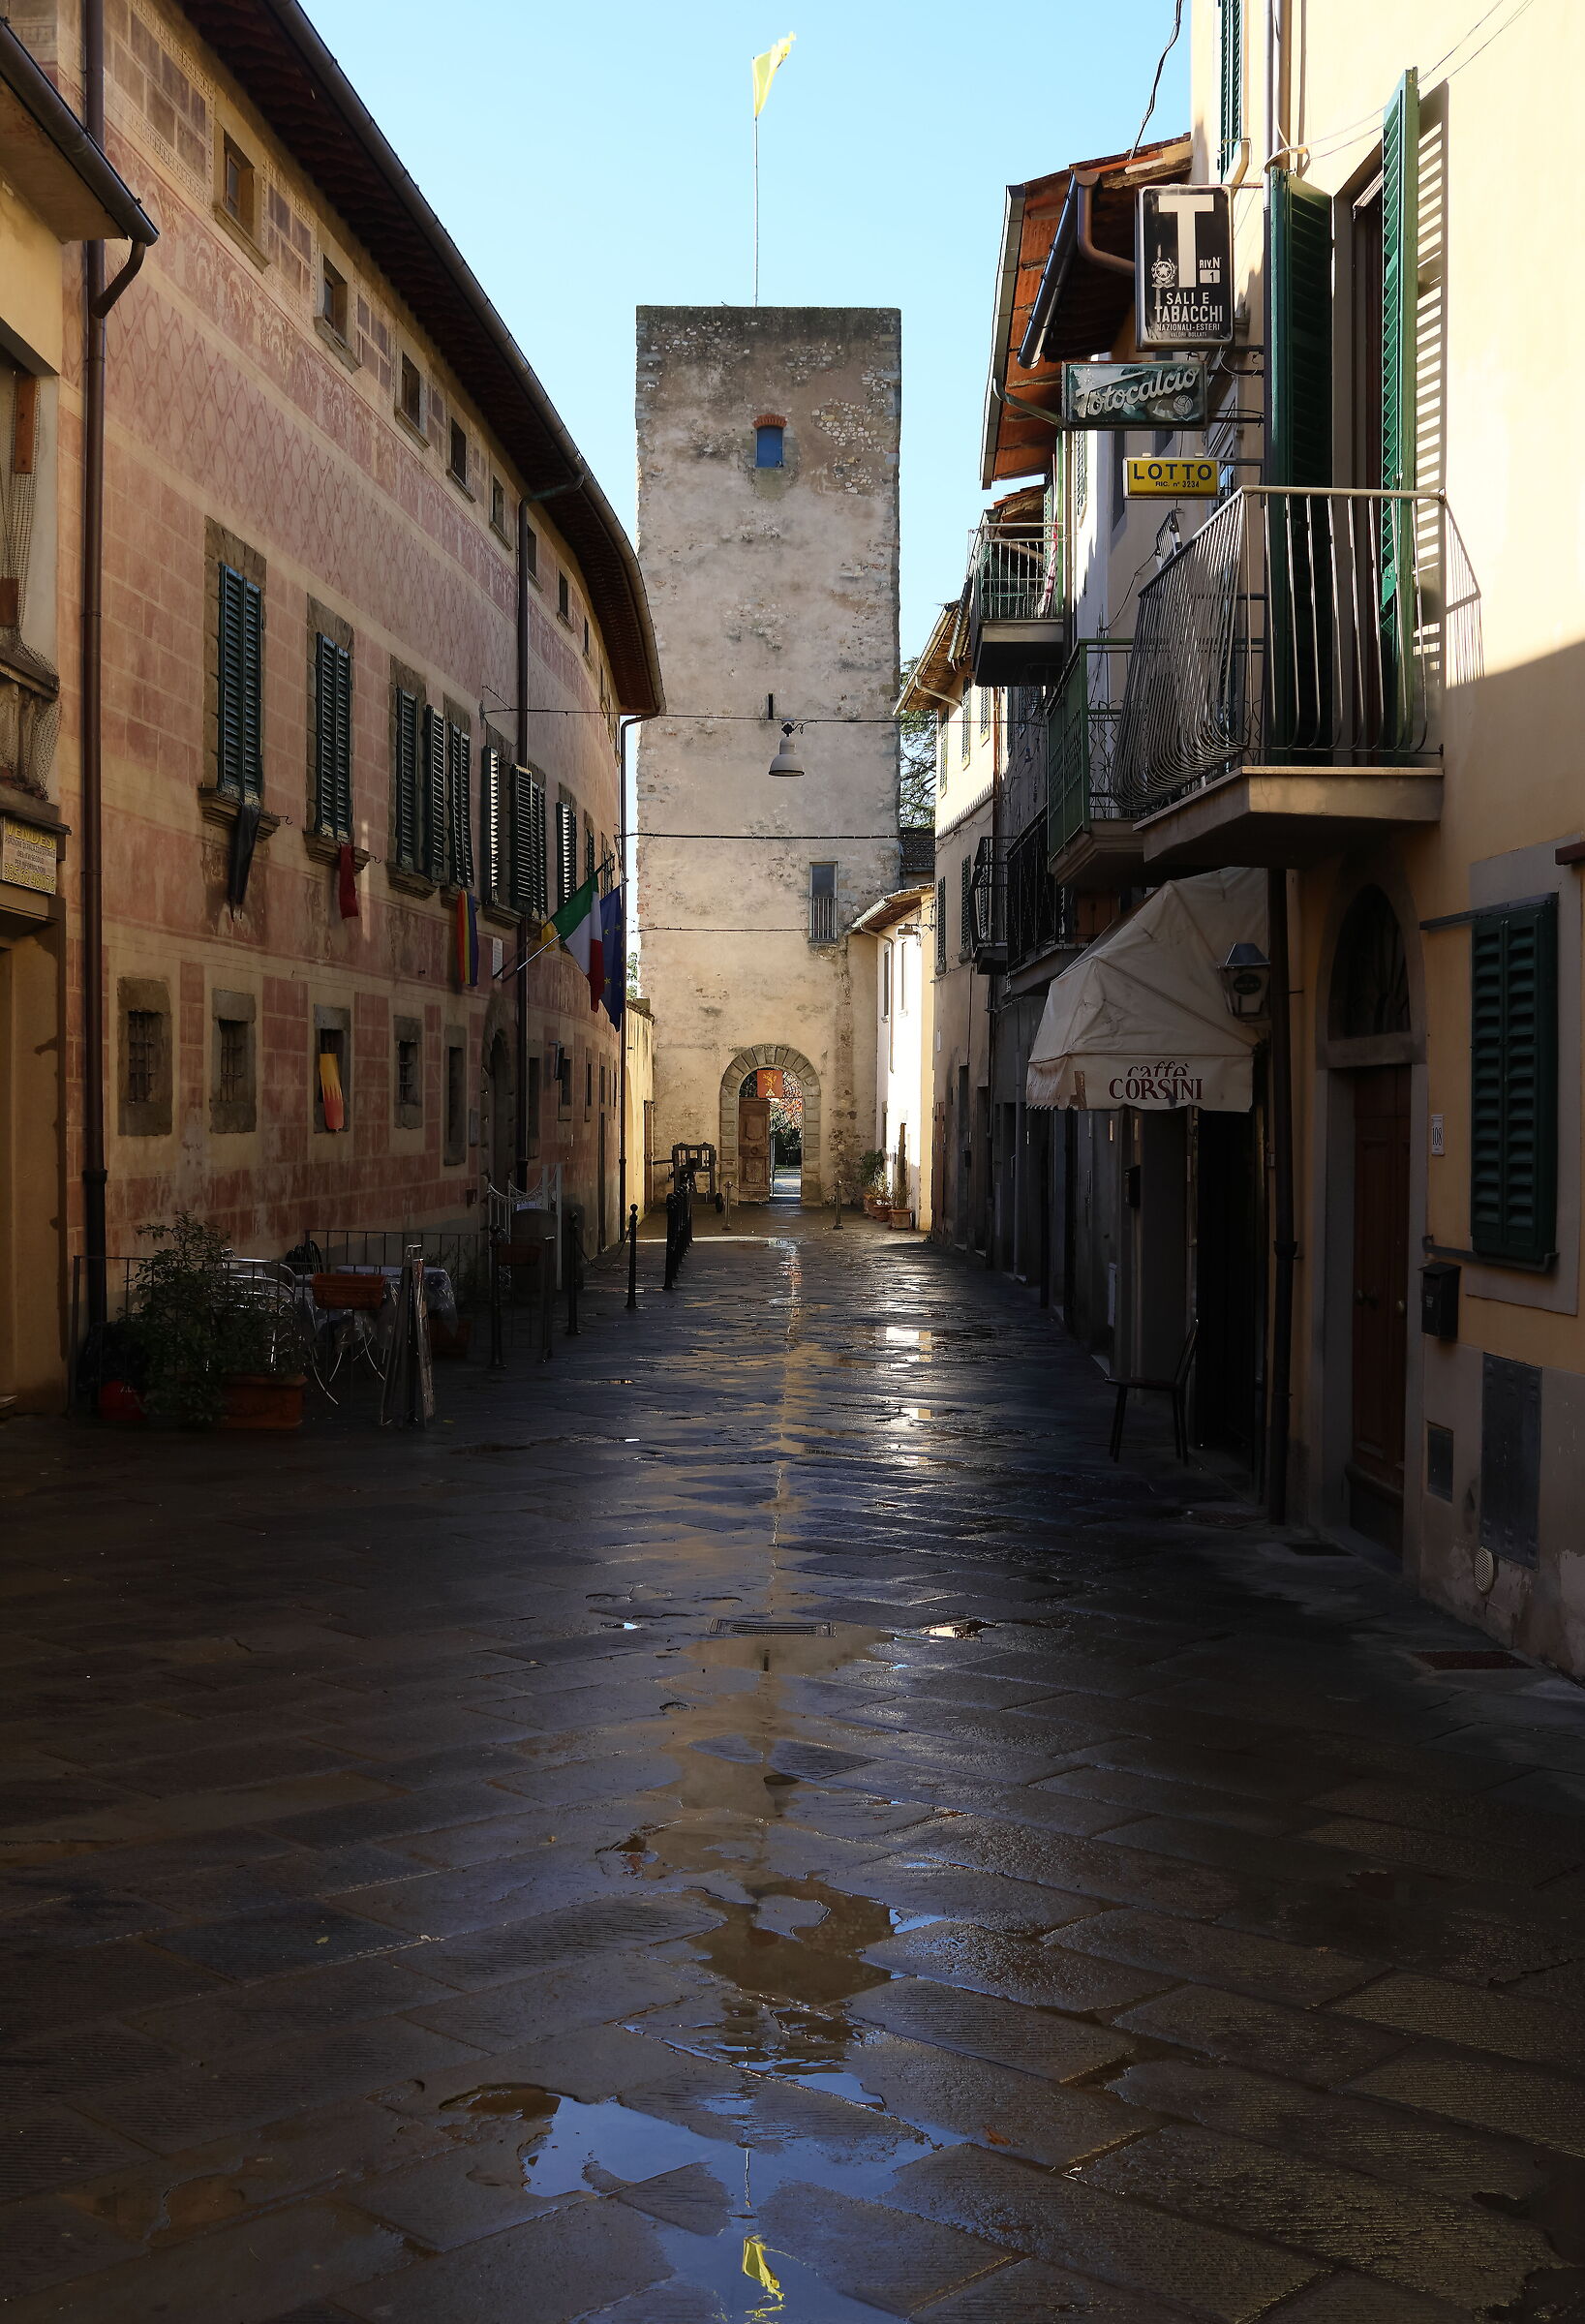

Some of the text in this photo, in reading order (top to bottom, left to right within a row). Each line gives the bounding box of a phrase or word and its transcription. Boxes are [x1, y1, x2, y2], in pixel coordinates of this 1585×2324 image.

[1158, 195, 1214, 289] T
[1209, 272, 1215, 283] 1
[1166, 291, 1209, 305] SALI E
[1154, 305, 1223, 322] TABACCHI
[1075, 365, 1201, 418] Totocalcio
[1133, 463, 1212, 481] LOTTO
[1127, 1060, 1190, 1078] caffè
[1109, 1078, 1204, 1100] CORSINI
[1432, 1127, 1443, 1147] 108
